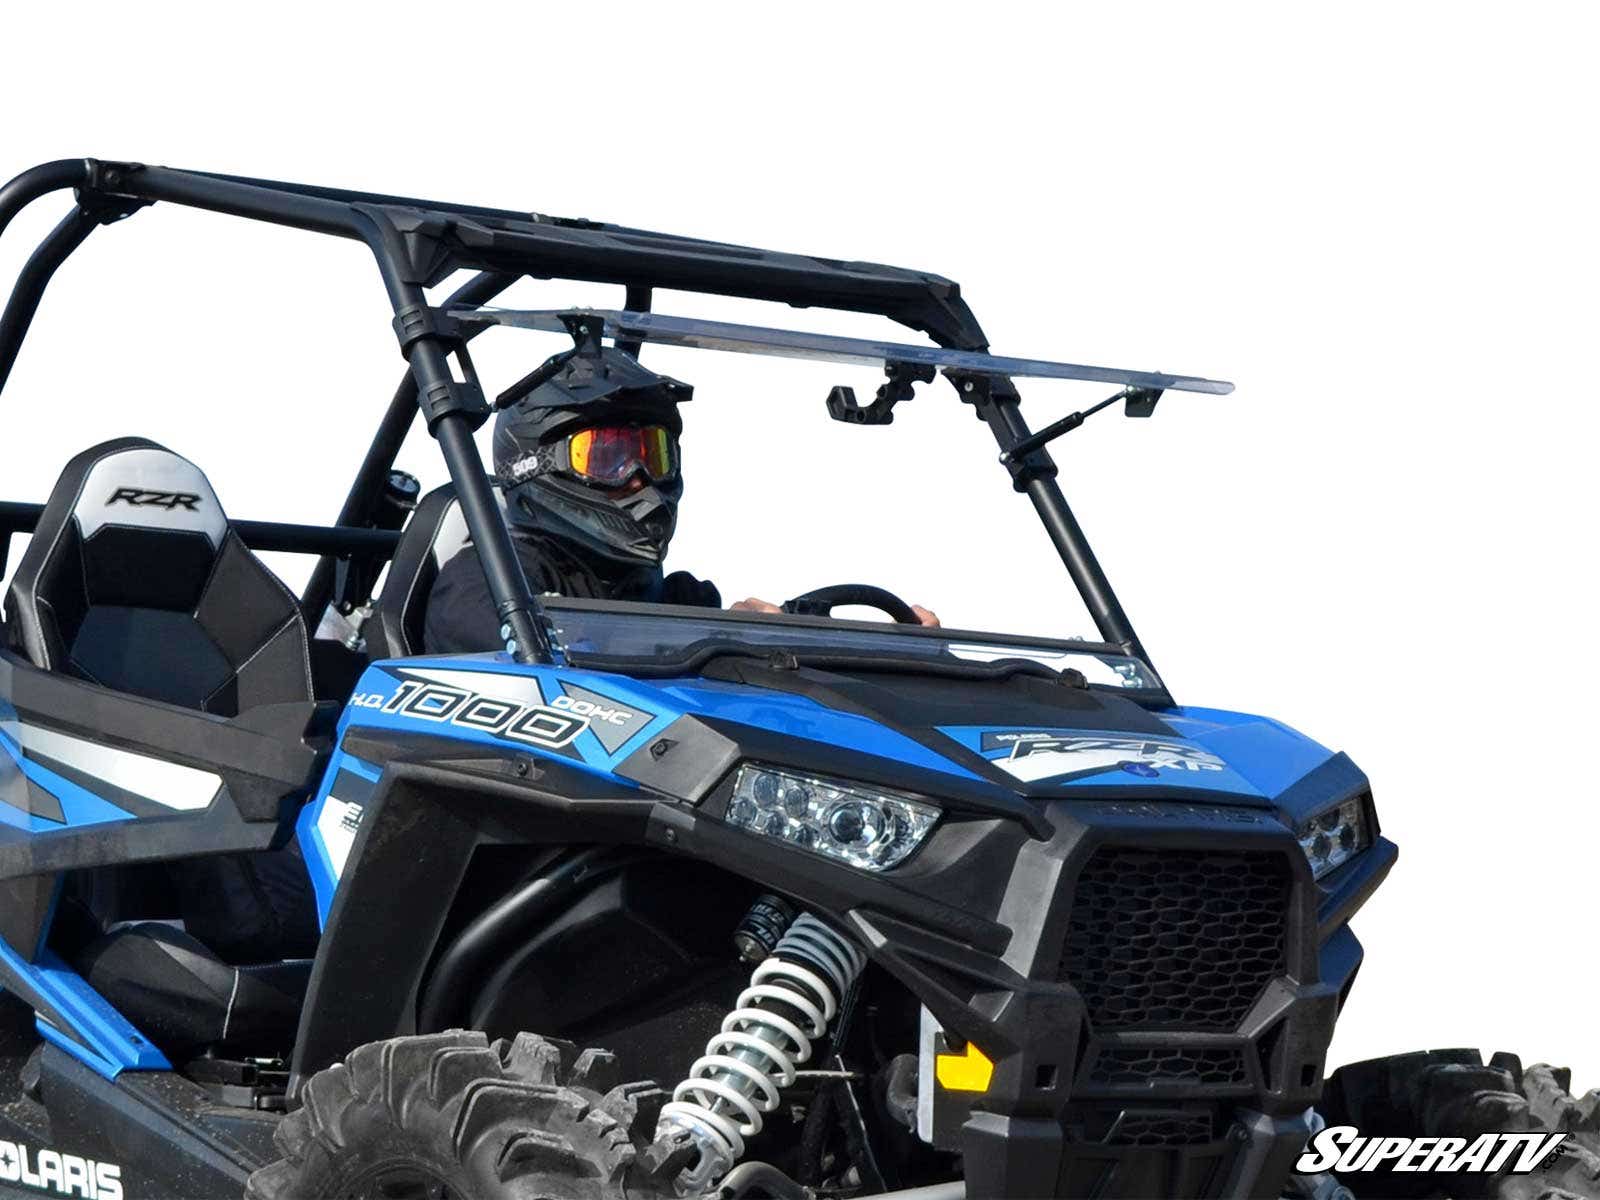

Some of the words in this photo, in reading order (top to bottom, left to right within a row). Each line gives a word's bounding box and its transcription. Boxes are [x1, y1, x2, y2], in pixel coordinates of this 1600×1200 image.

[105, 488, 202, 512] RZR
[381, 680, 591, 748] 1000
[551, 695, 633, 726] DOHC
